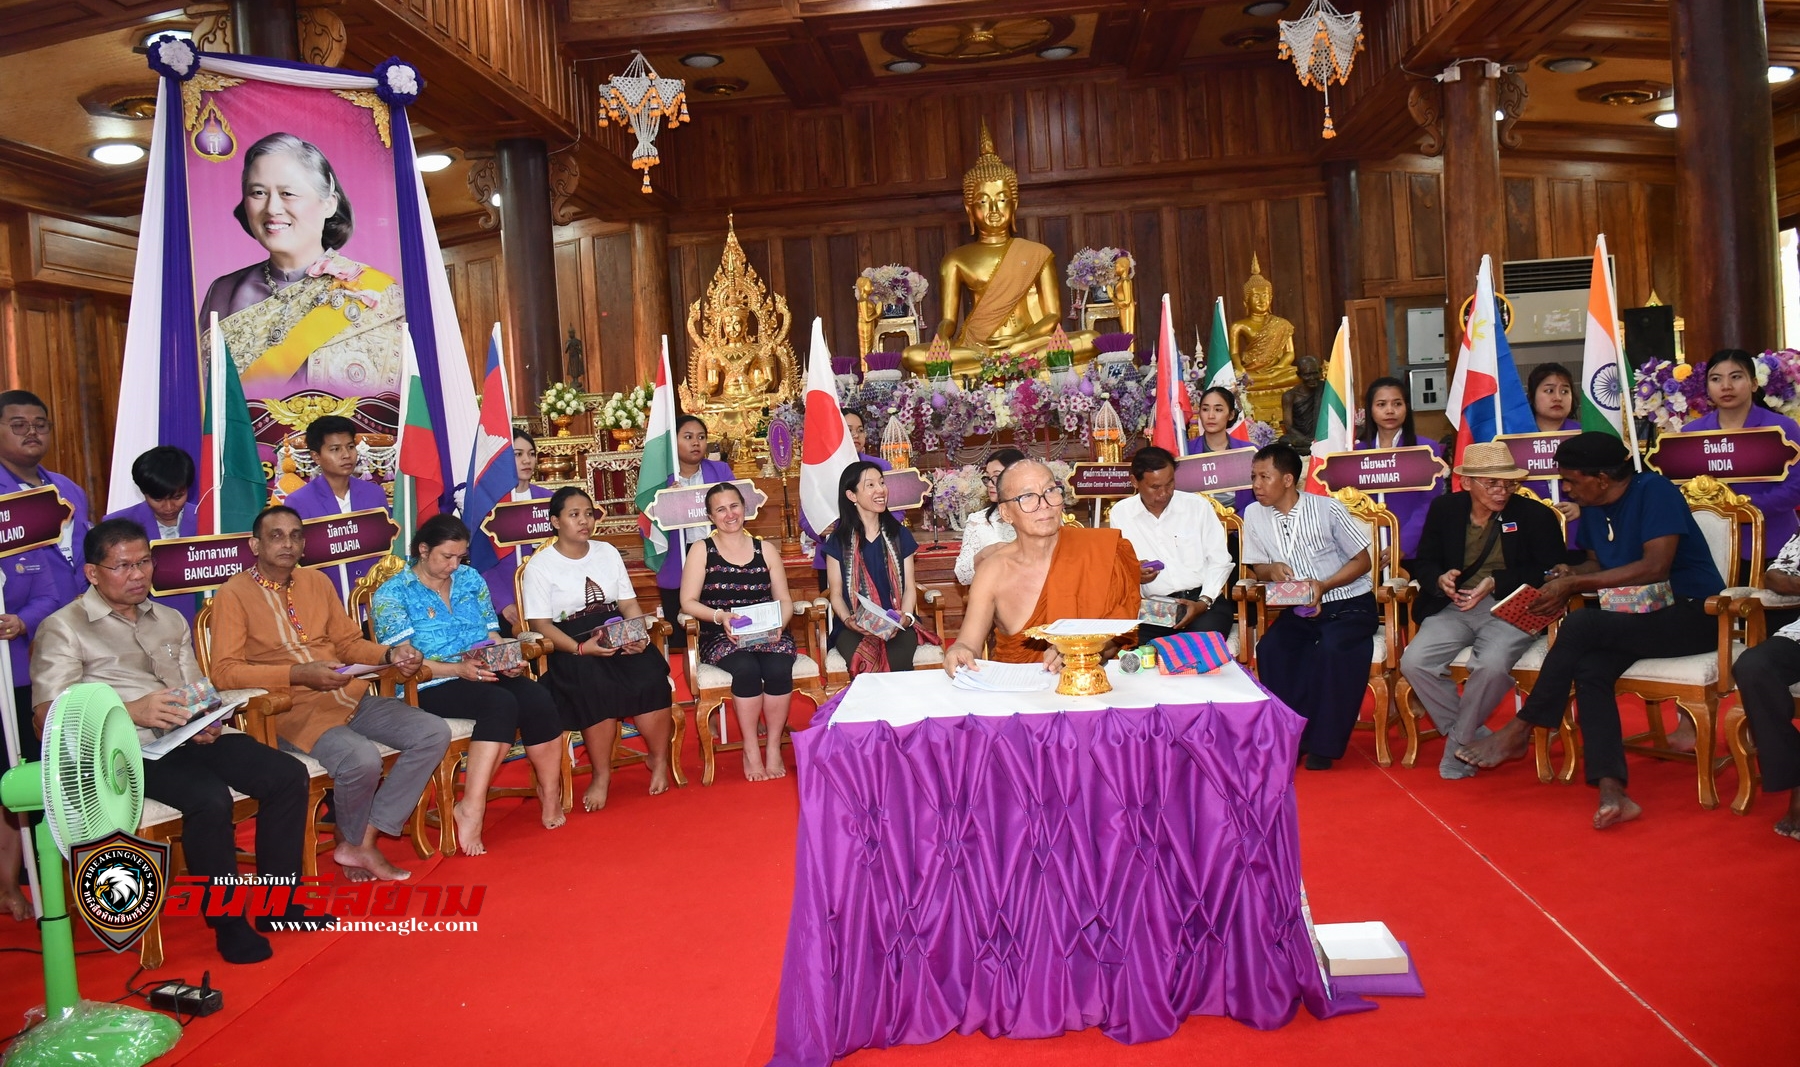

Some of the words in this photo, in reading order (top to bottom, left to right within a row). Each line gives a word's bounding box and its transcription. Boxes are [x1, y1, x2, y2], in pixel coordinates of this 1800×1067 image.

[1703, 437, 1735, 454] อินเดีย
[1202, 462, 1216, 472] ลาว
[1360, 453, 1396, 470] เมียนมาร์
[1708, 458, 1734, 472] INDIA
[1203, 475, 1218, 486] LAO
[1358, 472, 1400, 485] MYANMAR
[187, 545, 239, 562] บังกาลาเทศ
[329, 539, 361, 555] BULARIA
[184, 562, 243, 581] BANGLADESH
